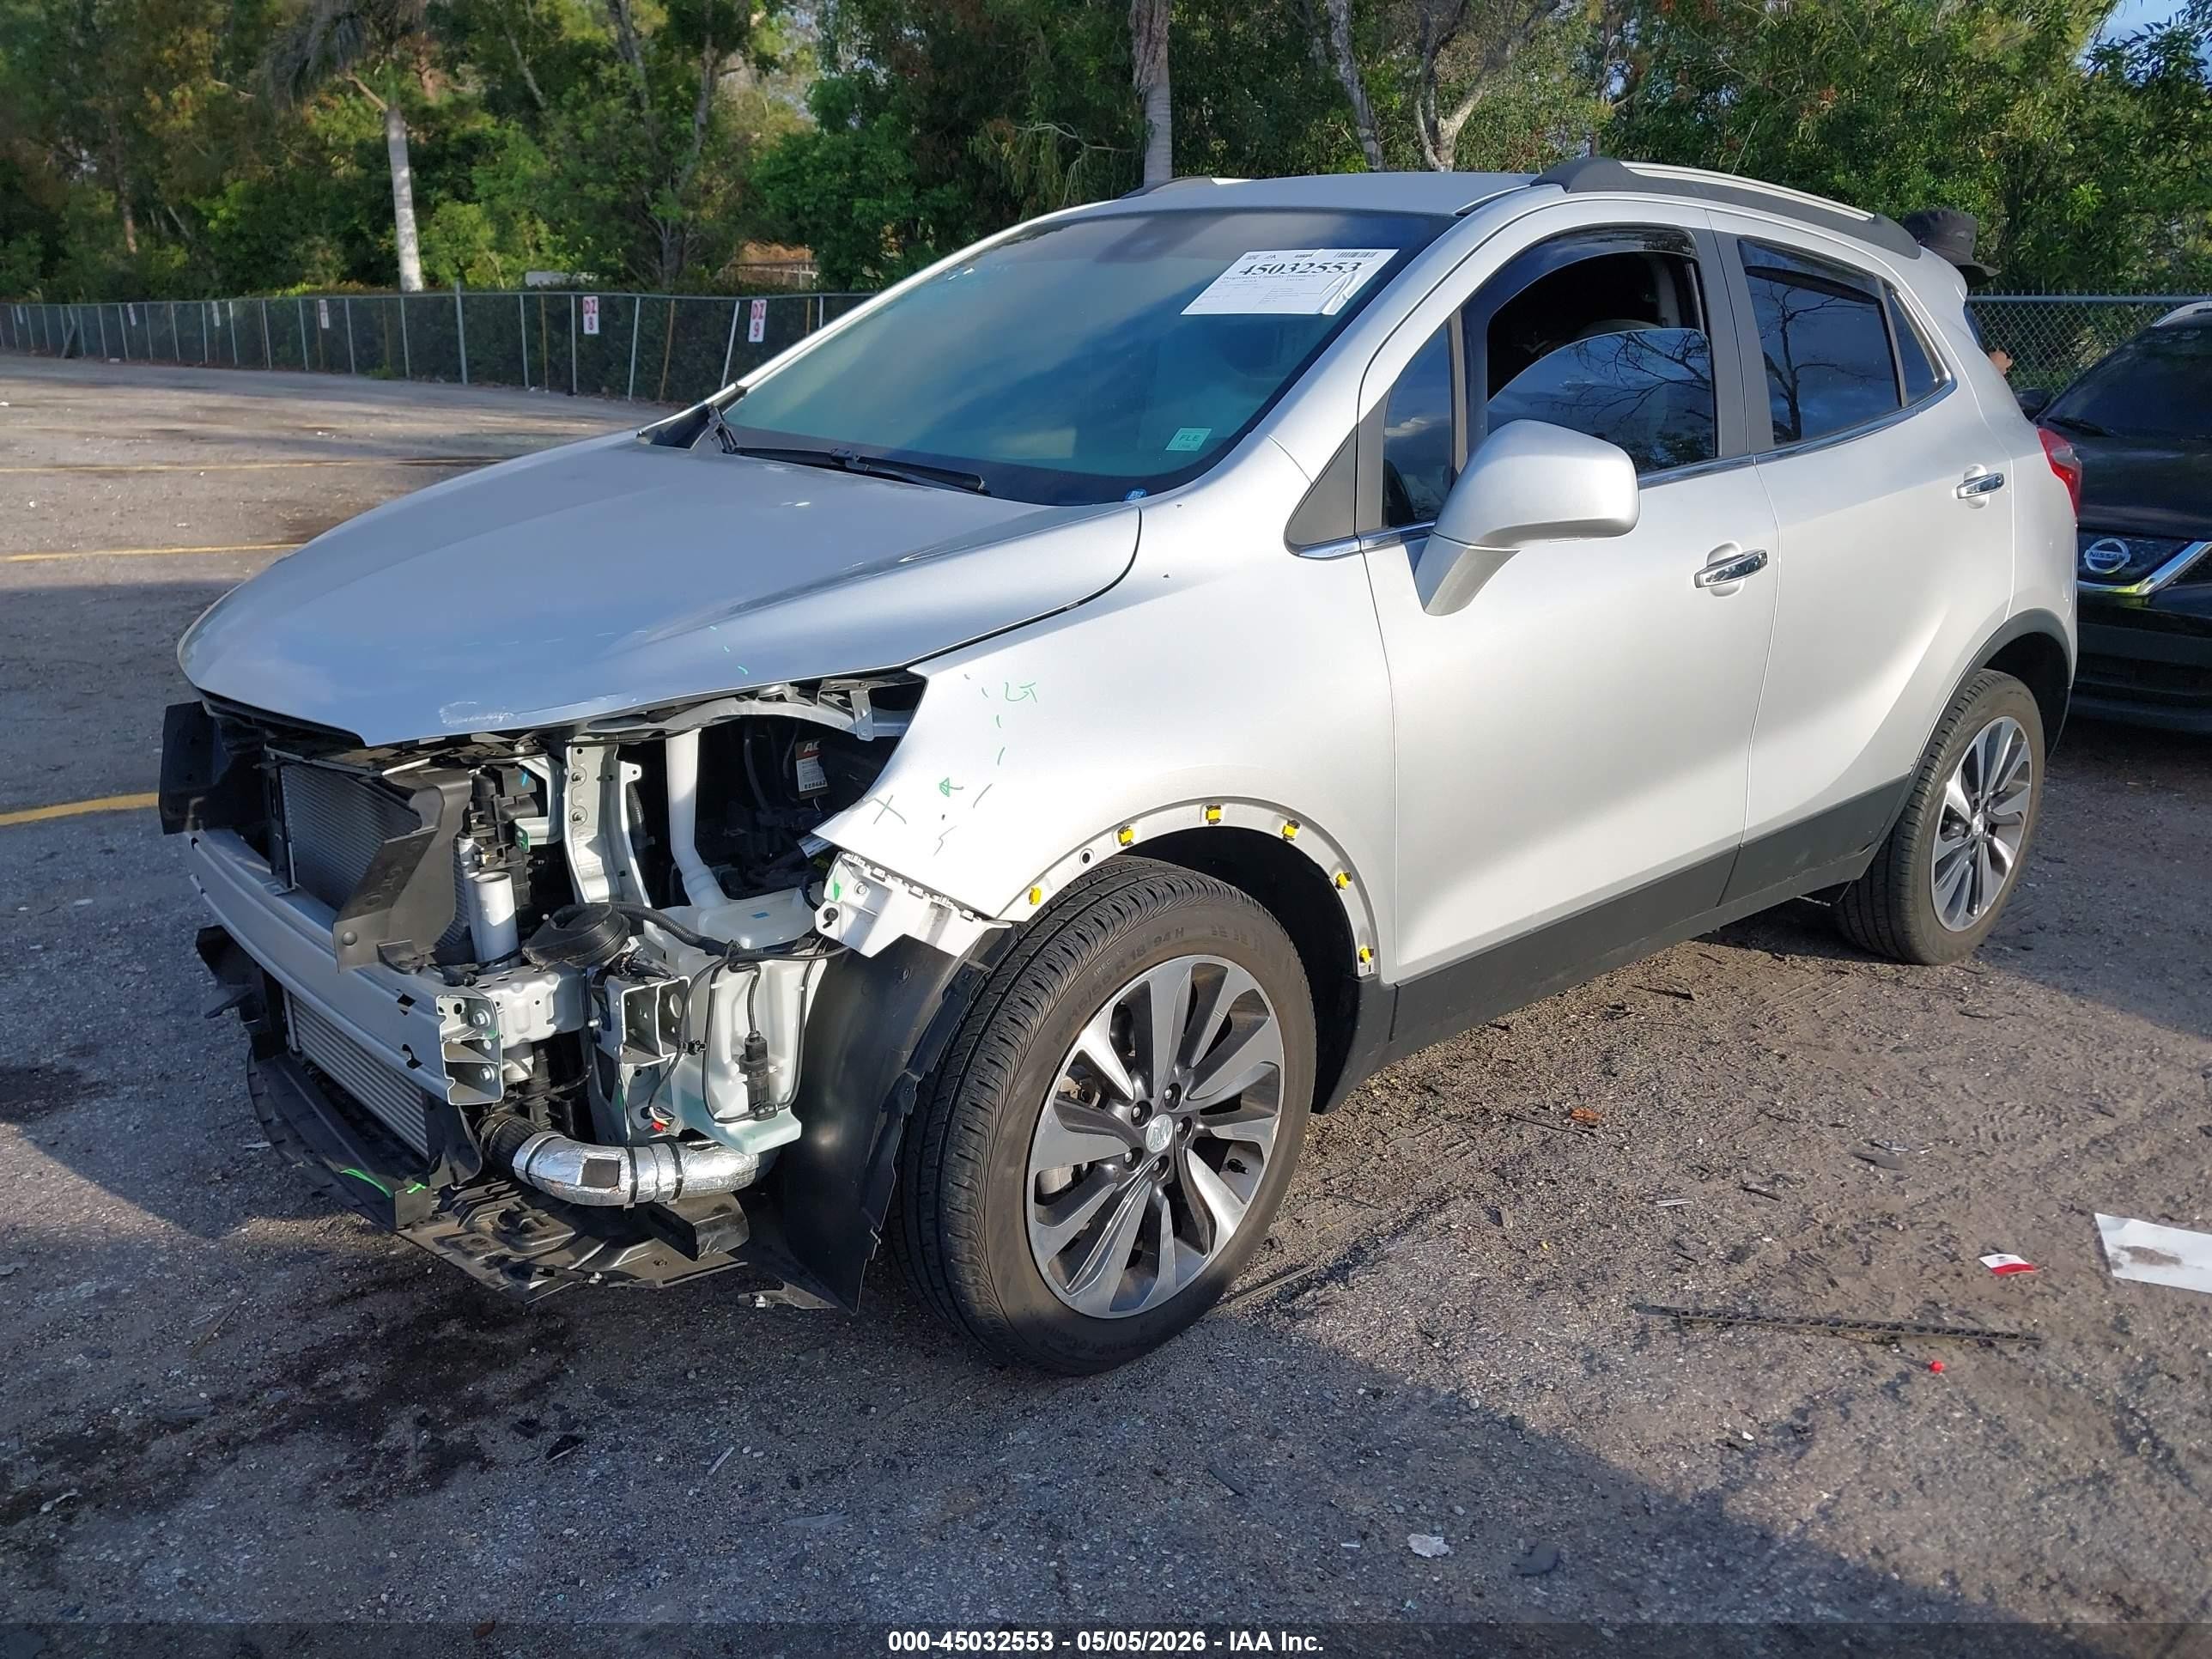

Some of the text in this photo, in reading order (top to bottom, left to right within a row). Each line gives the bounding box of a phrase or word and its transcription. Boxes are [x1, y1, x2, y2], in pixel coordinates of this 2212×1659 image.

[1238, 262, 1363, 275] 45032553
[588, 317, 594, 331] 8
[753, 322, 760, 337] 9
[2088, 551, 2125, 560] NISSAN
